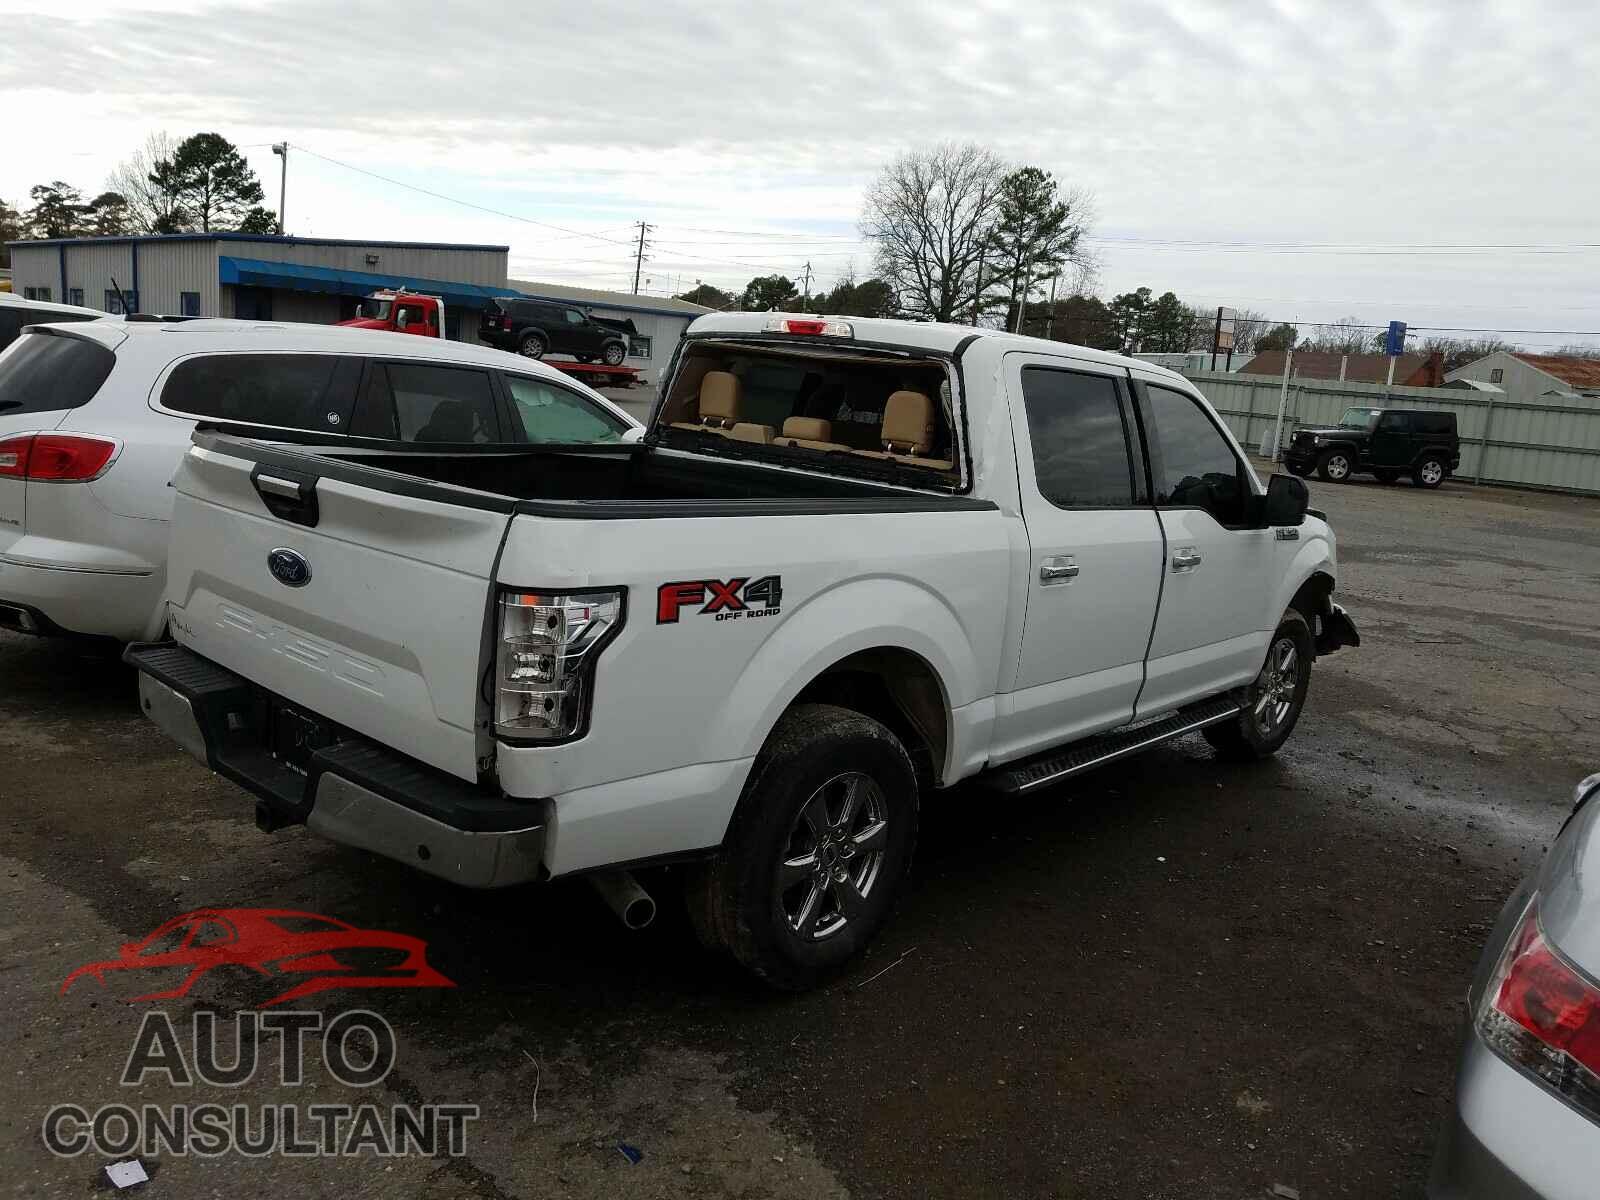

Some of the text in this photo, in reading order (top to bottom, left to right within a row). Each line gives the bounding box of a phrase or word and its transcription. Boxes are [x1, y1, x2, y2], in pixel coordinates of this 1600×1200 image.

[656, 575, 783, 625] FX4
[715, 608, 780, 621] OFF ROAD
